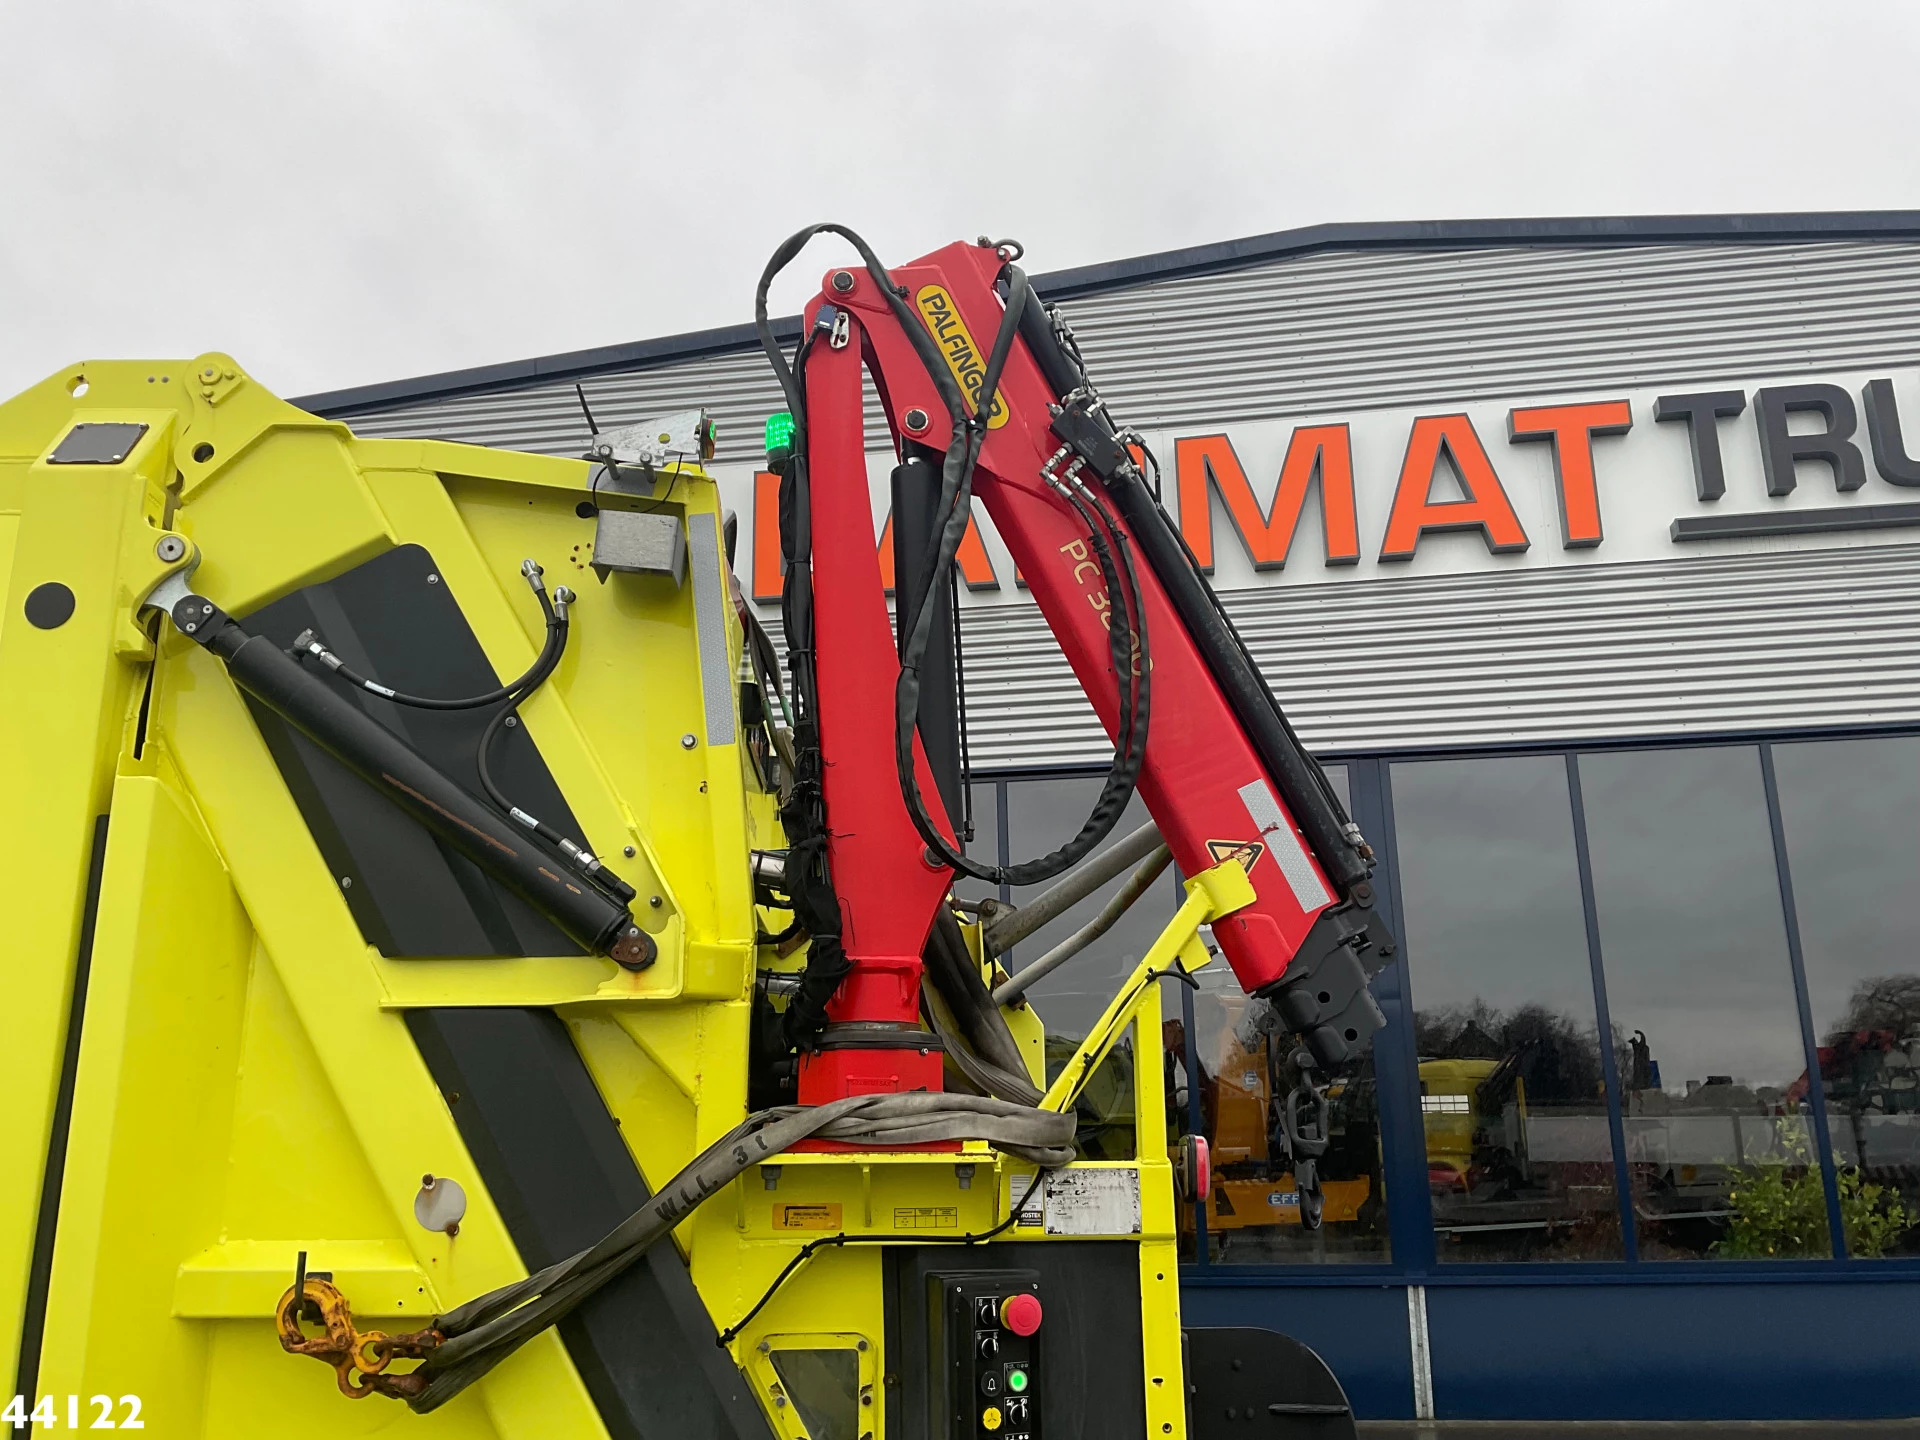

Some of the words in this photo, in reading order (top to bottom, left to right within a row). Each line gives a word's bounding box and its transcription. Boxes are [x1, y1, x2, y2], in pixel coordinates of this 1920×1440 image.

[1059, 538, 1101, 585] PC
[655, 1174, 718, 1221] W.L.L.
[732, 1145, 749, 1165] 3
